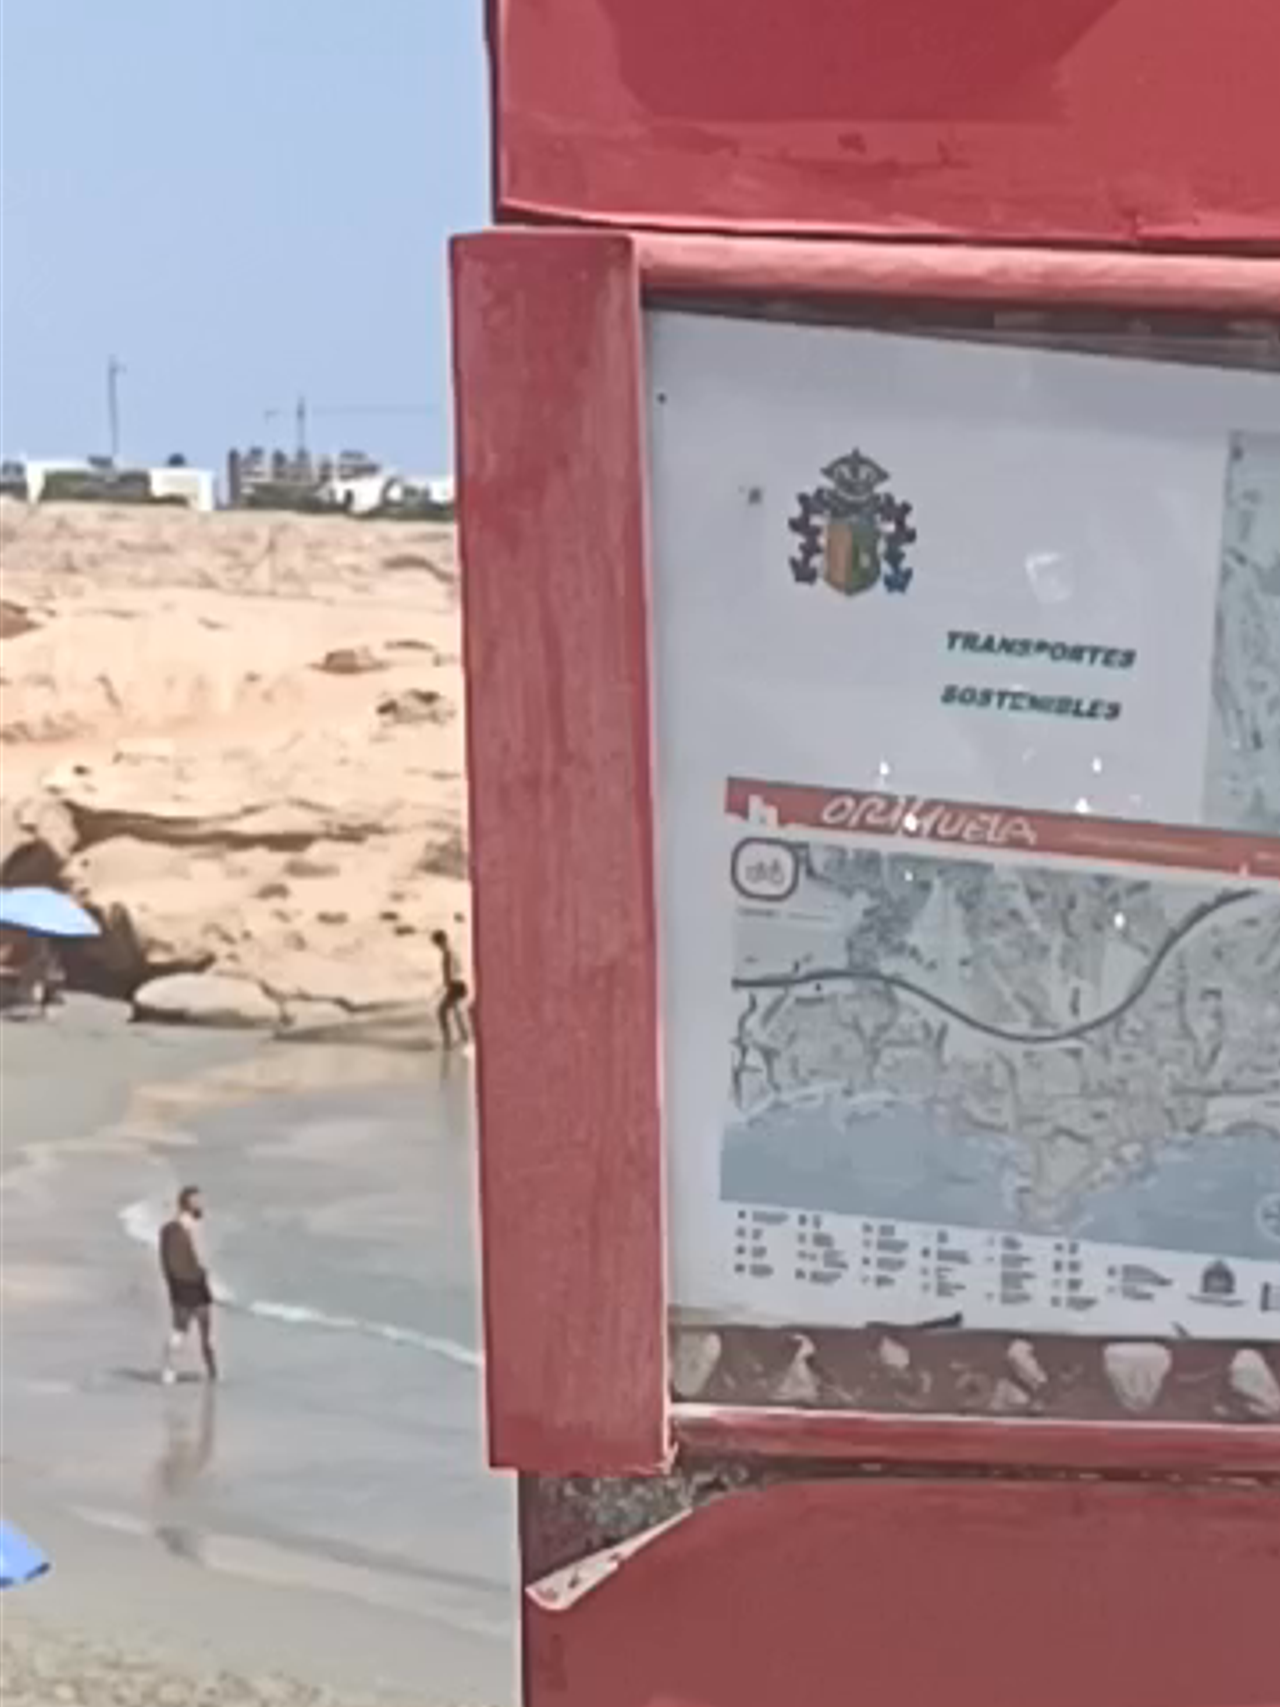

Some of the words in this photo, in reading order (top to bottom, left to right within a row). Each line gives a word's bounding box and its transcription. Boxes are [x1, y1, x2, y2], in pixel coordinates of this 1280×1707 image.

[946, 630, 1137, 669] TRANSPORTES
[940, 684, 1122, 721] SOSTENIBLES
[822, 794, 1038, 846] ORIHUELA
